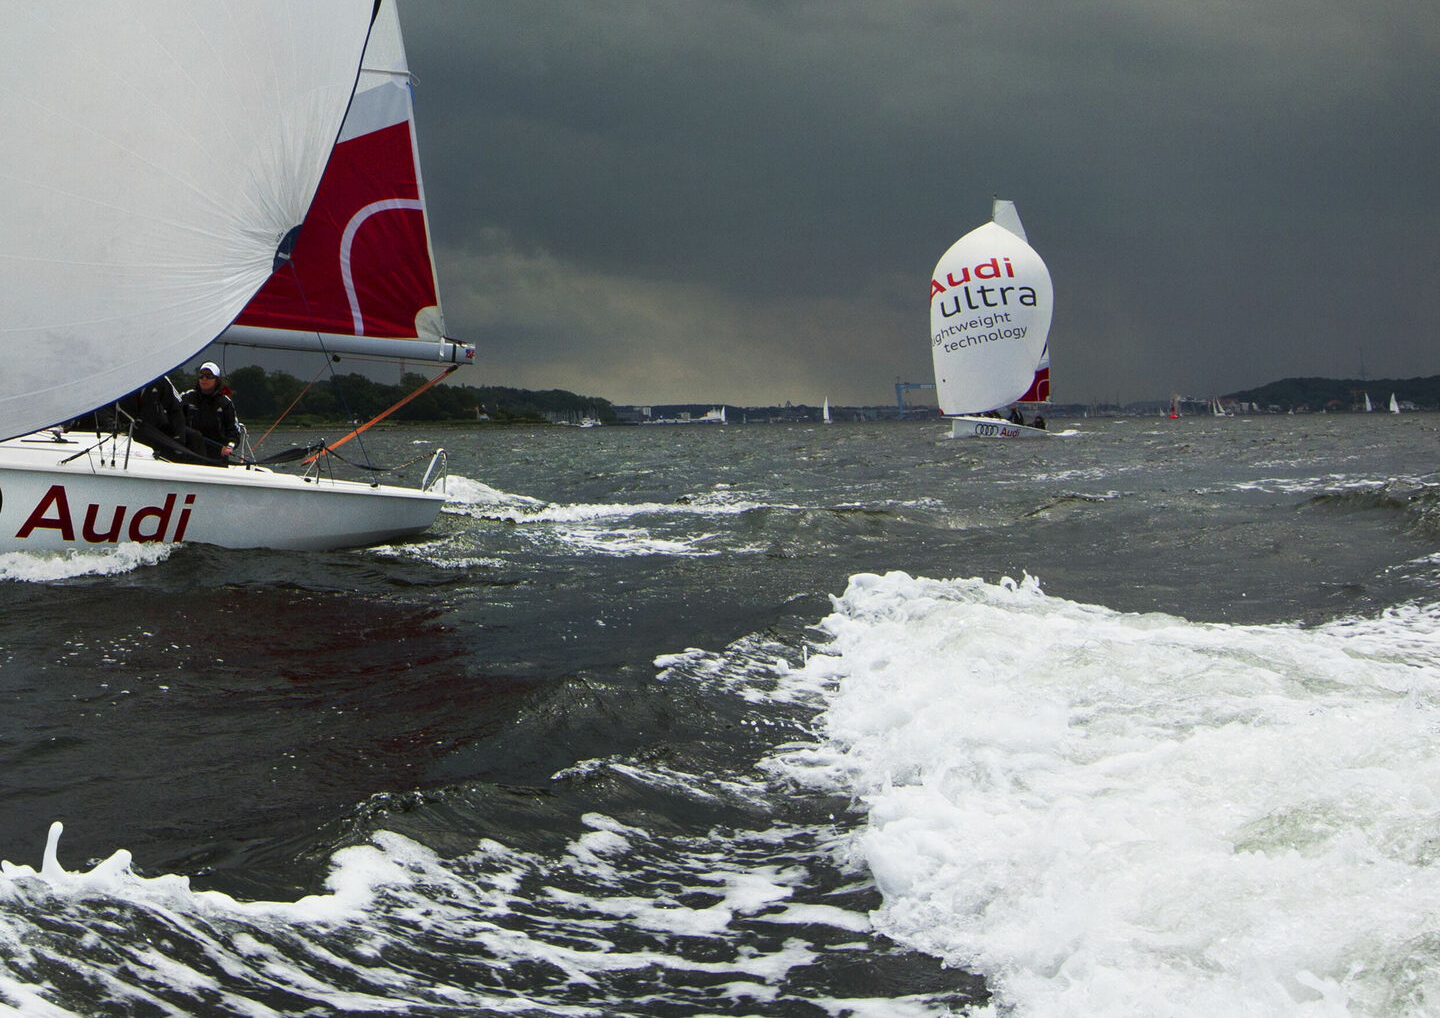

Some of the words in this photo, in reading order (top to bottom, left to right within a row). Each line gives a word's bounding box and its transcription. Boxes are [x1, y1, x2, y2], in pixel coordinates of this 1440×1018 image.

[930, 257, 1014, 304] Audi
[940, 285, 1037, 318] ultra
[944, 326, 1028, 353] technology
[1000, 426, 1021, 438] Audi
[15, 484, 197, 543] Audi
